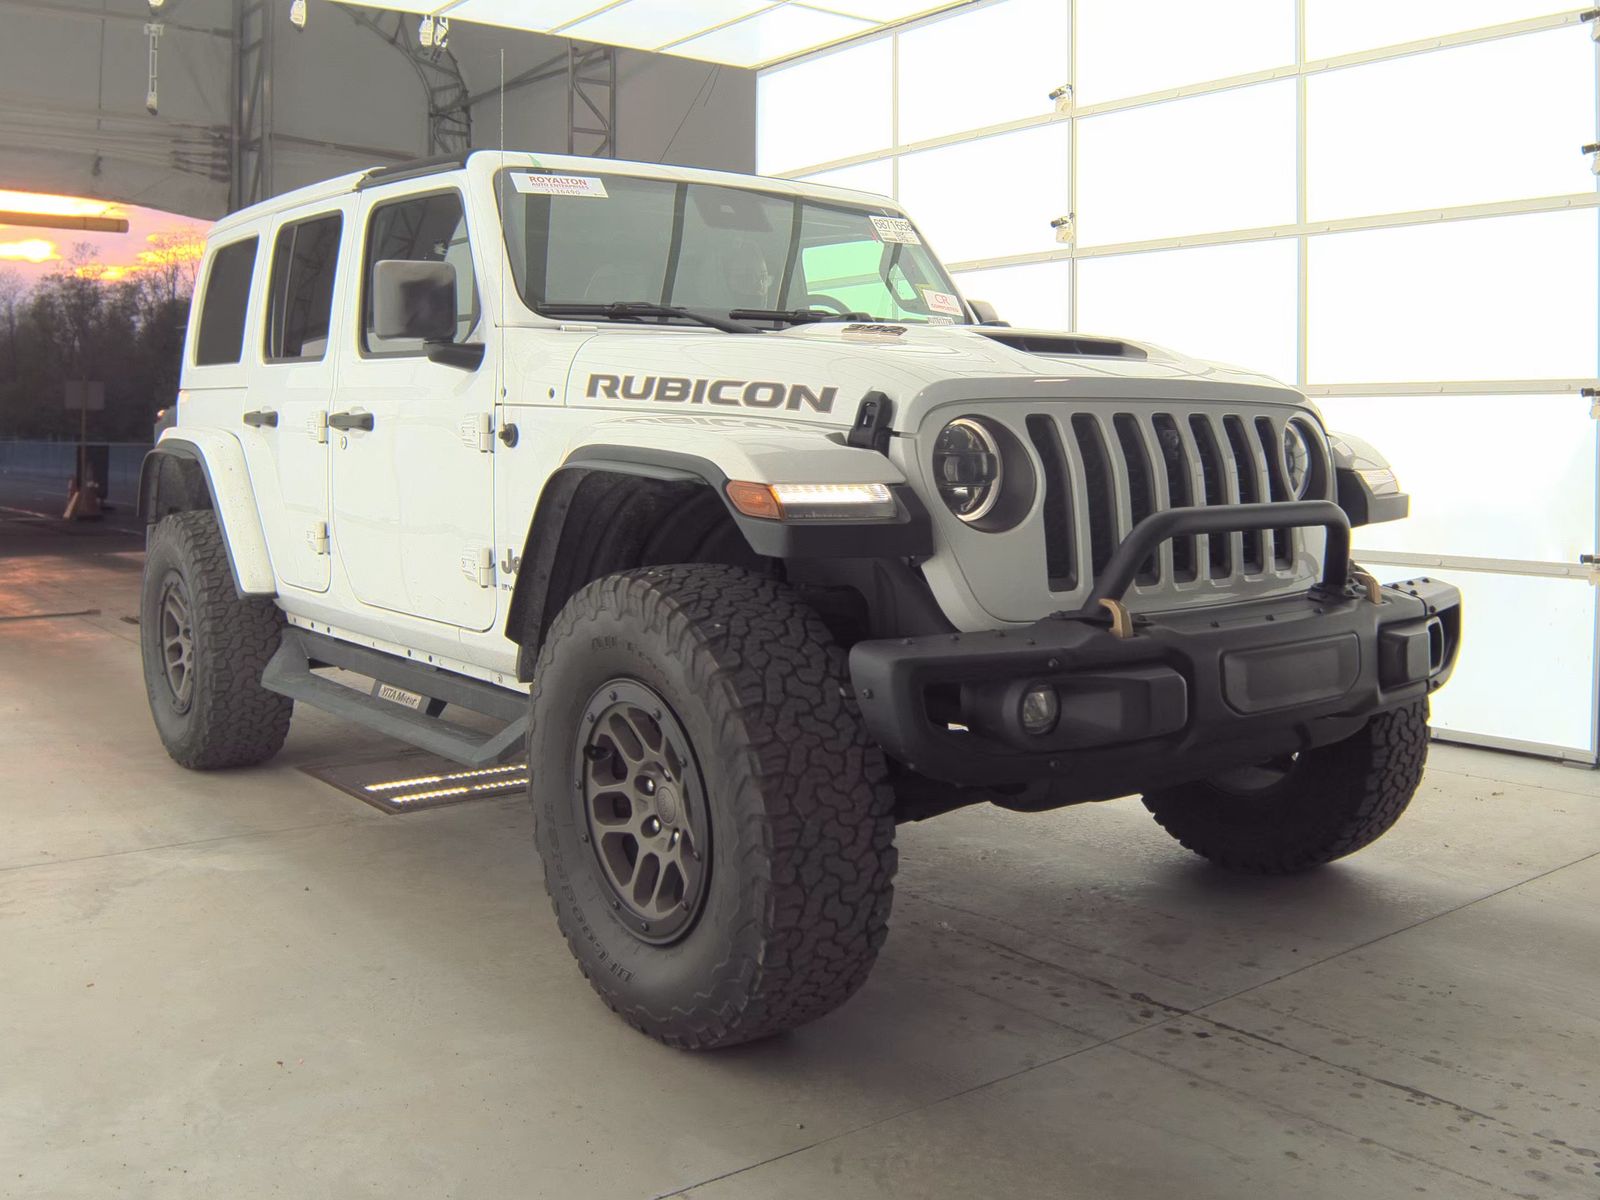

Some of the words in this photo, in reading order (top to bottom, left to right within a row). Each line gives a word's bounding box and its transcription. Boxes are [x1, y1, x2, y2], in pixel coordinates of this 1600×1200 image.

[528, 176, 587, 186] ROYALTON
[585, 373, 839, 414] RUBICON
[501, 548, 521, 575] Je
[382, 687, 396, 699] VITA
